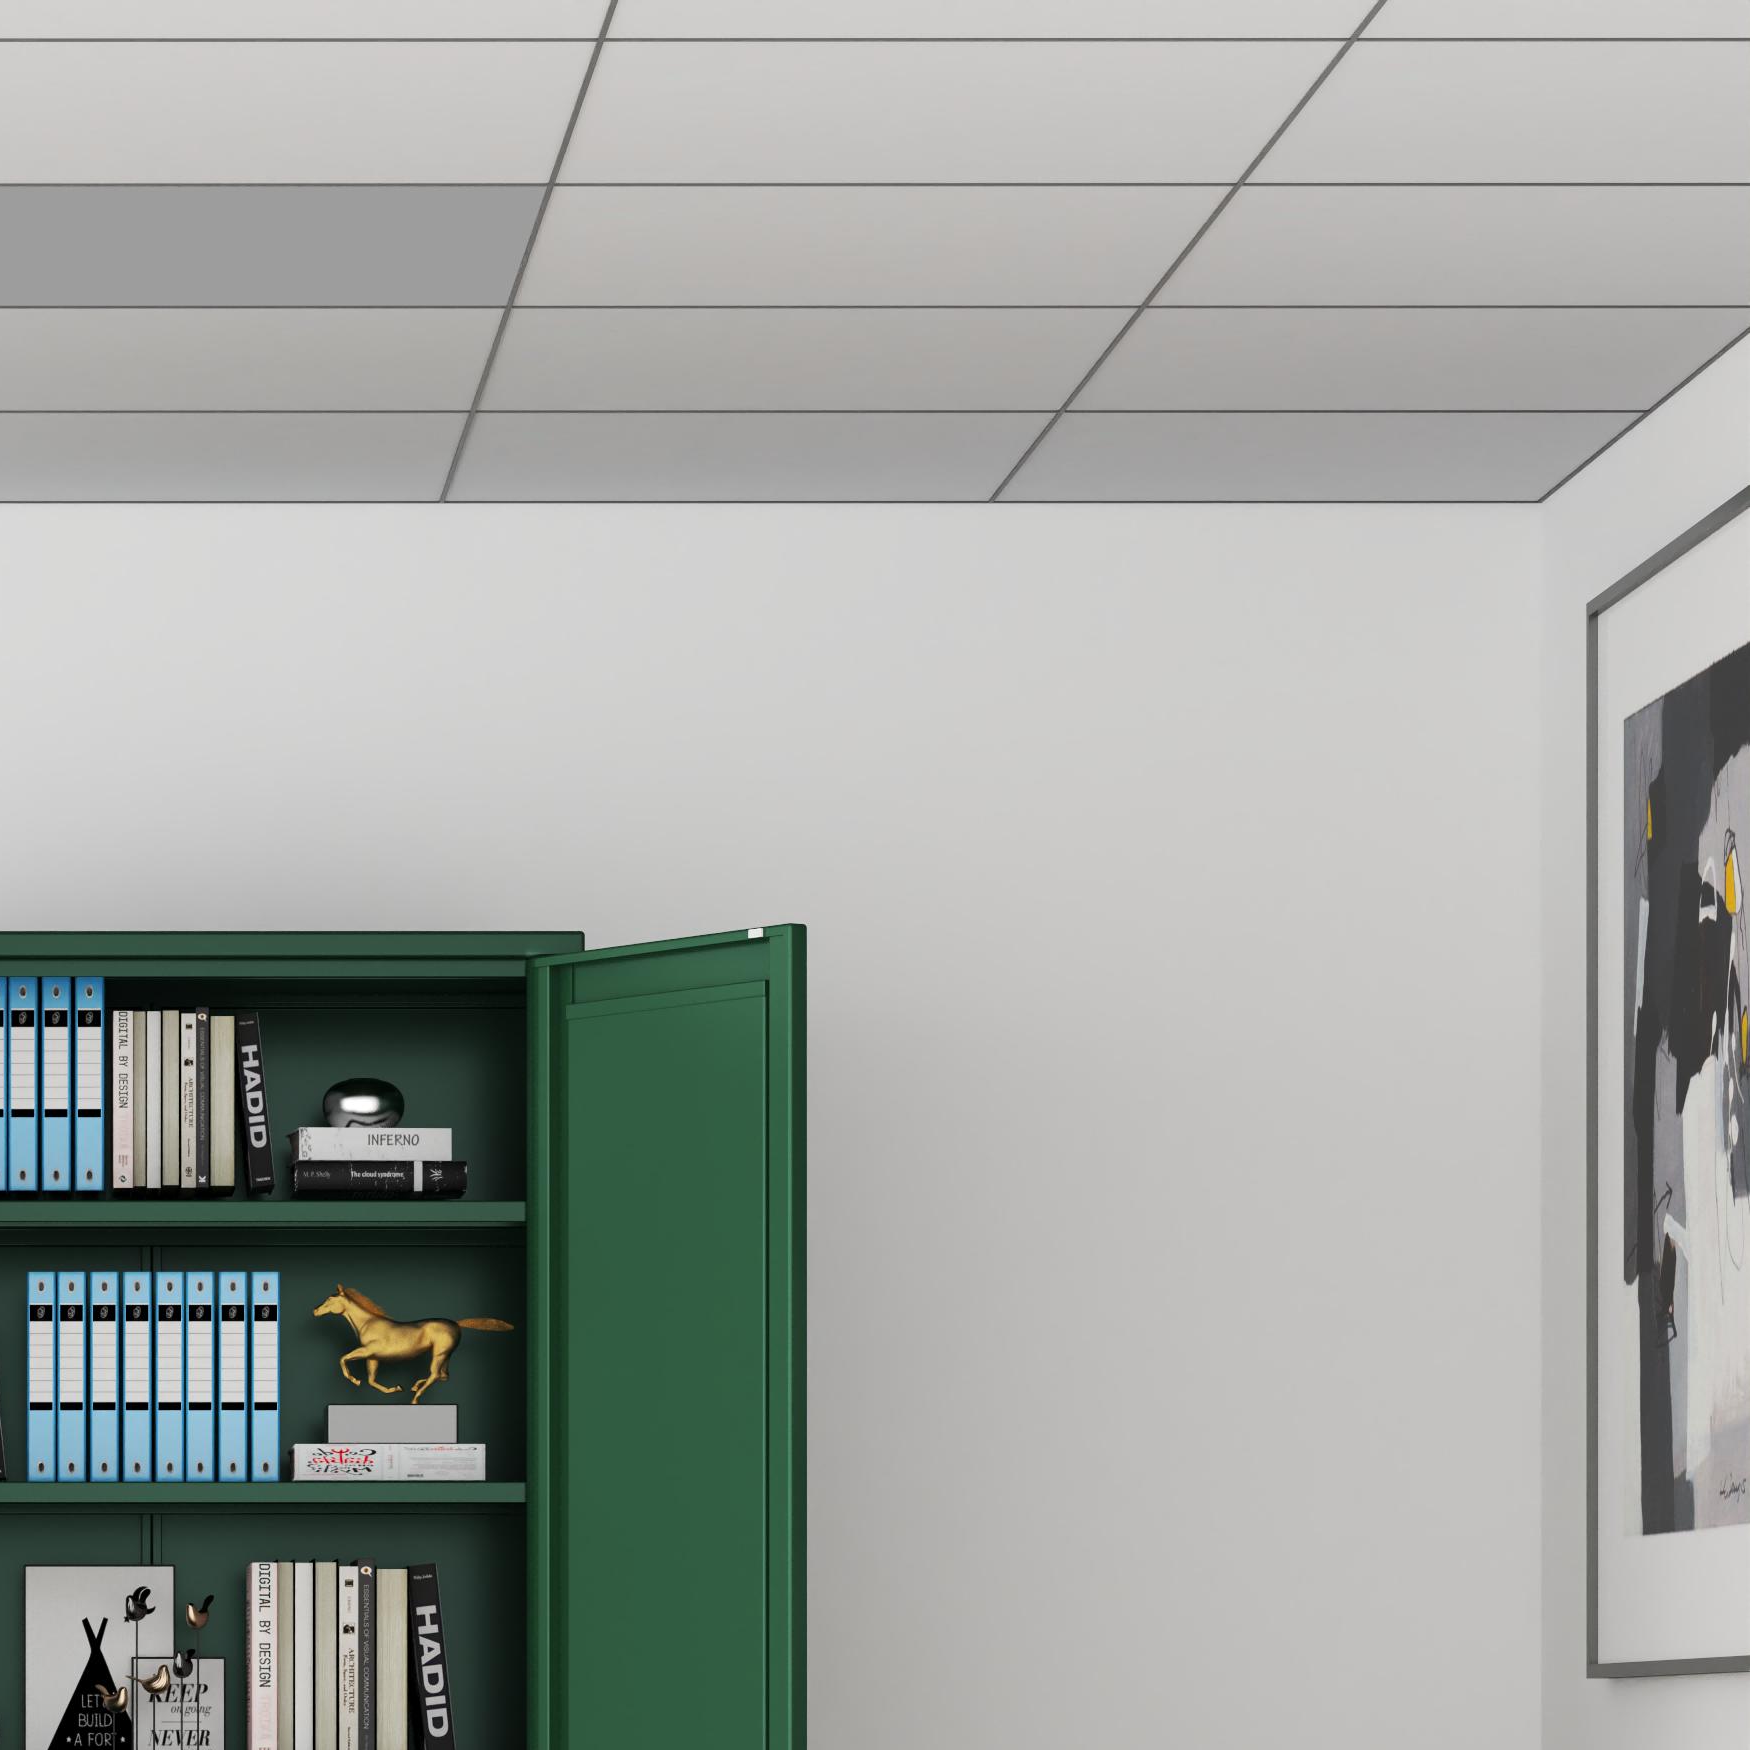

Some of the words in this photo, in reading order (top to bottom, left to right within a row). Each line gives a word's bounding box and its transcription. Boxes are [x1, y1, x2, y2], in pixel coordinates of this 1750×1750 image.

[118, 1011, 128, 1050] DIGITAL
[118, 1056, 128, 1067] BY
[118, 1073, 128, 1109] DESIGN
[241, 1044, 267, 1149] HADID
[368, 1134, 420, 1146] INFERNO
[259, 1563, 271, 1612] DIGITAL
[259, 1620, 271, 1634] BY
[363, 1629, 370, 1639] OF
[259, 1642, 271, 1688] DESIGN
[415, 1605, 449, 1738] HADID
[78, 1713, 113, 1727] BUILD
[74, 1732, 83, 1746] A
[148, 1729, 210, 1746] NEVER
